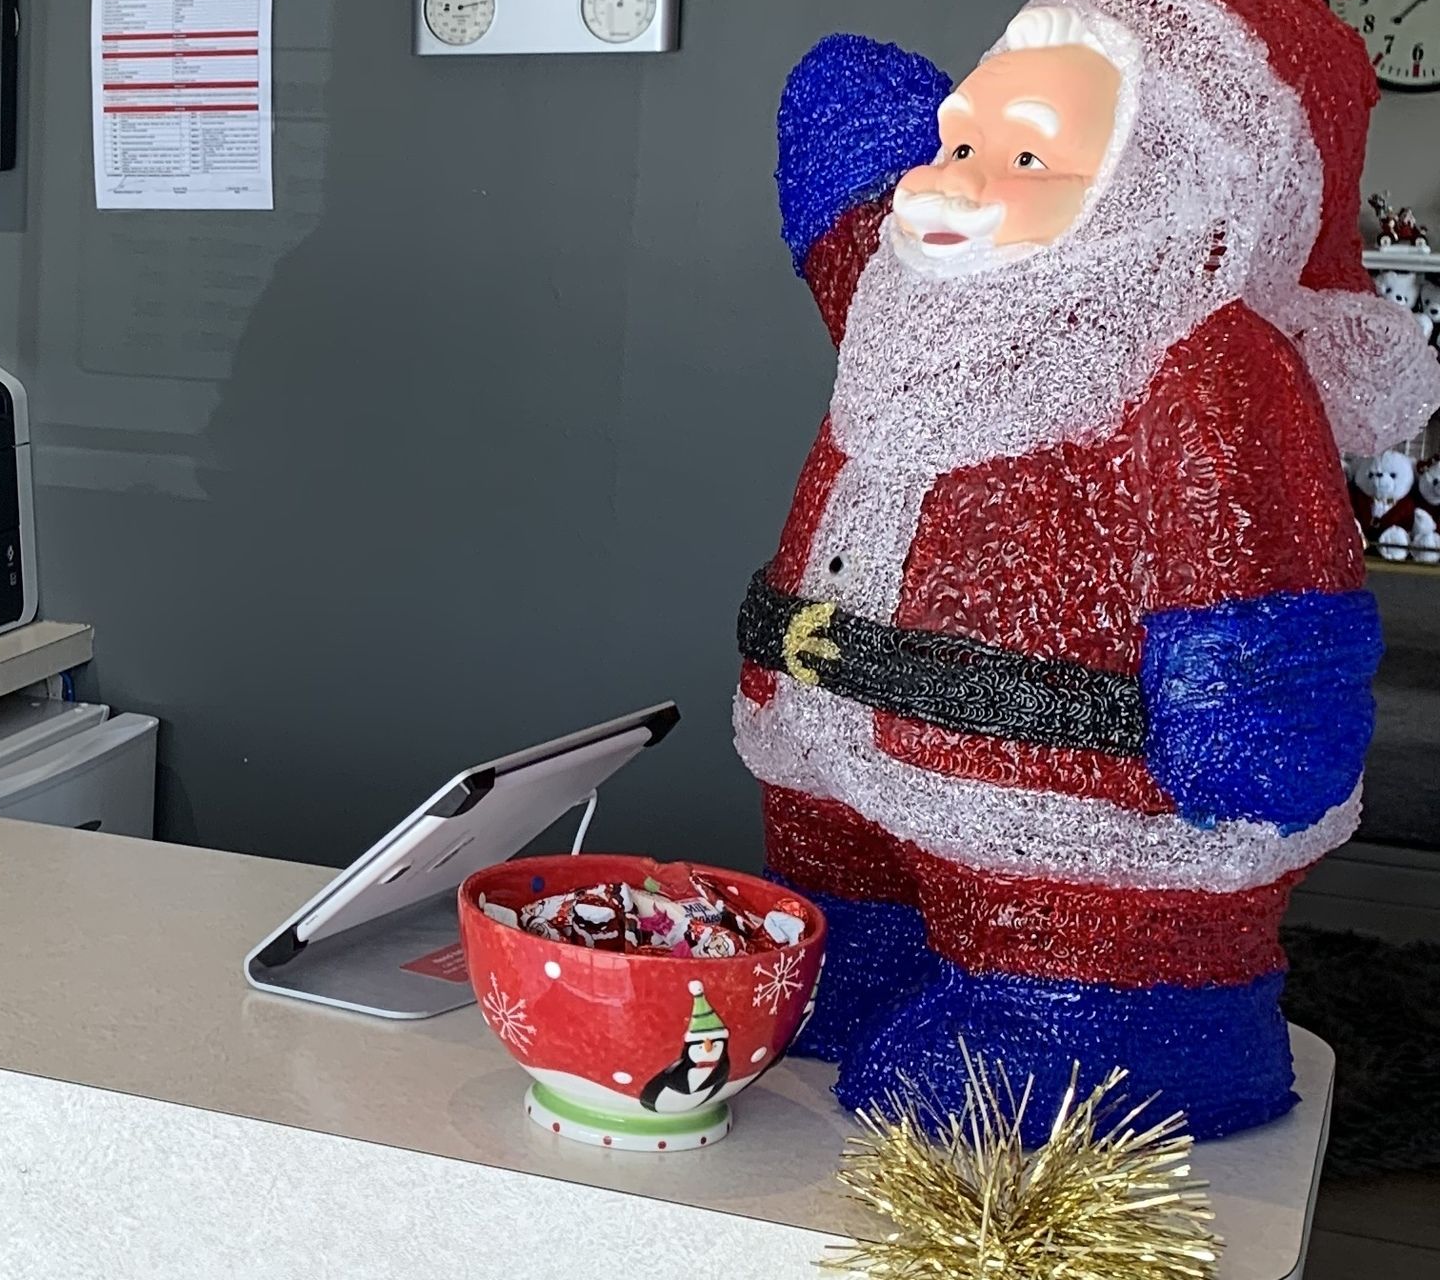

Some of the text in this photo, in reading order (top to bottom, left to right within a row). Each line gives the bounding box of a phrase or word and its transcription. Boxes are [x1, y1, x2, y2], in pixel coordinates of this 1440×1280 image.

[1363, 14, 1376, 34] 8
[1384, 35, 1395, 55] 7
[1412, 43, 1424, 62] 6
[681, 902, 711, 913] Milk
